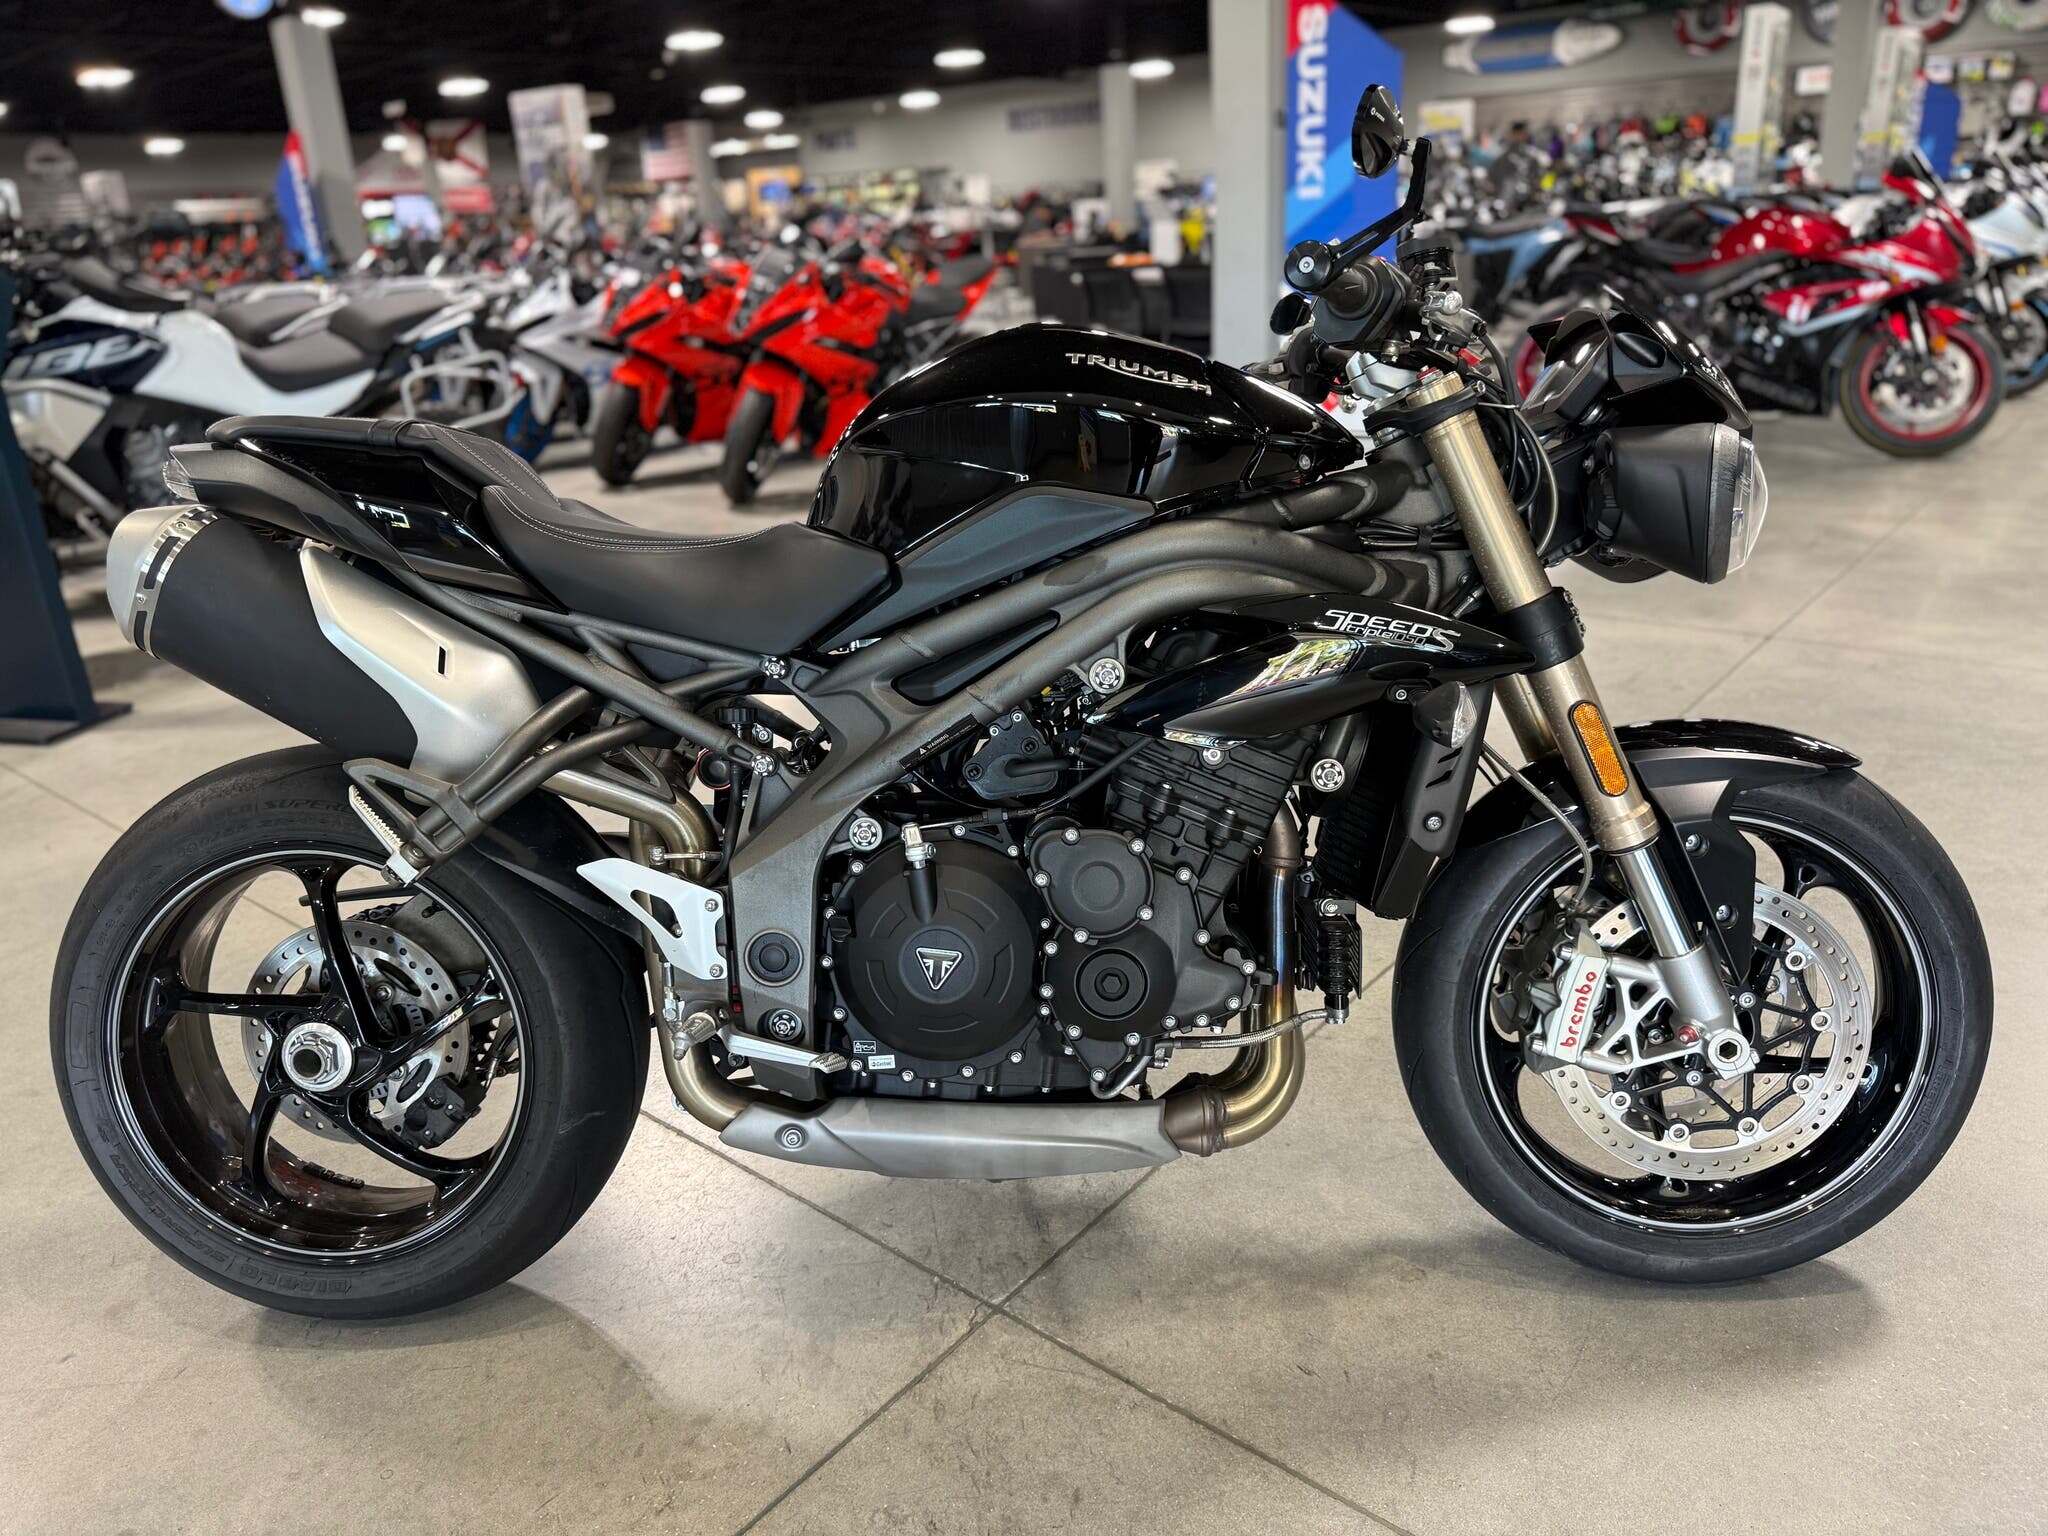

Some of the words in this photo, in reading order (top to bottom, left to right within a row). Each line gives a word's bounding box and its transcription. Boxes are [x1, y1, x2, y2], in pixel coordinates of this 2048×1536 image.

[1295, 3, 1328, 199] SUZUKI
[1065, 353, 1212, 396] TRIUMPH
[1560, 971, 1598, 1047] brembo
